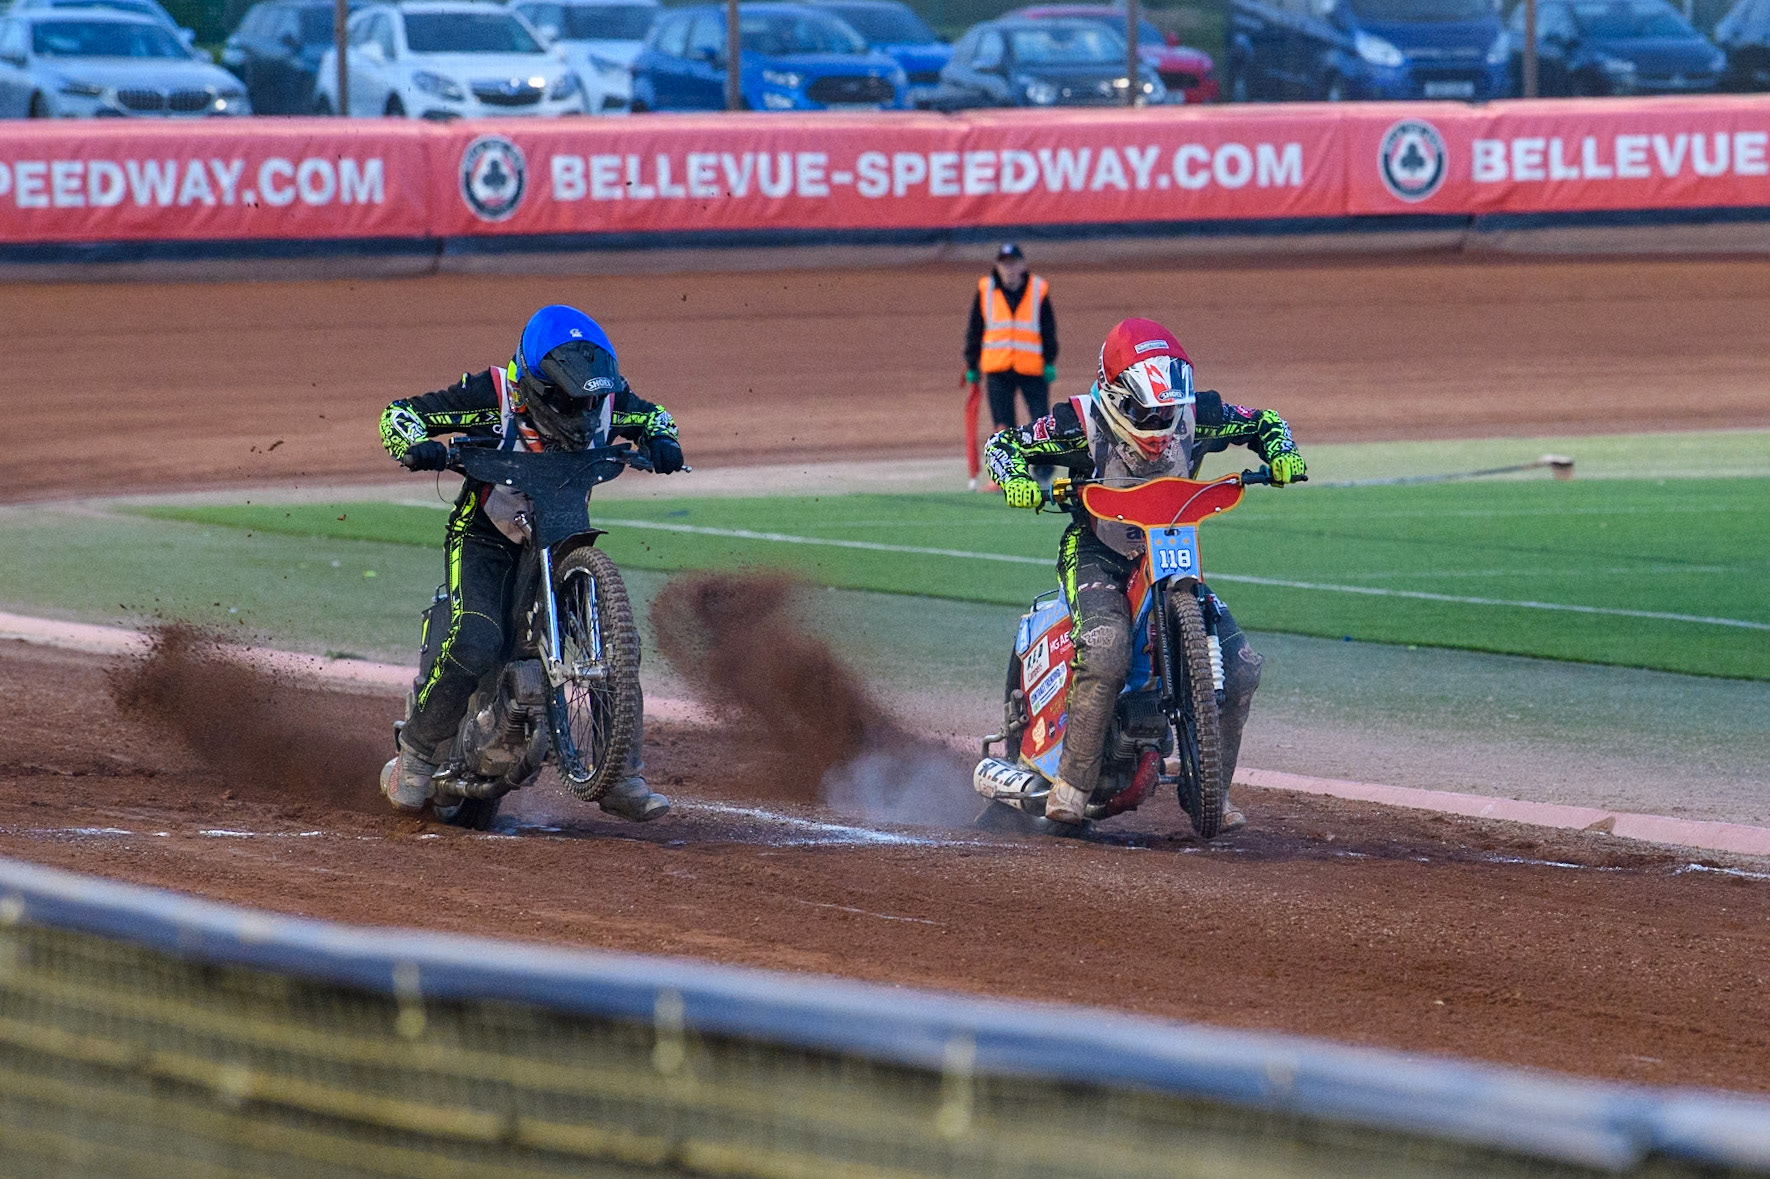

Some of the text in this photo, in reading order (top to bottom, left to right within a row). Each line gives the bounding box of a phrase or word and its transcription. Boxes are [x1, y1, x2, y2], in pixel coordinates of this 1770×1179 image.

[551, 143, 1304, 202] BELLEVUE-SPEEDWAY.COM
[1472, 131, 1770, 184] BELLEVUE
[587, 380, 611, 390] SHOEI
[1158, 548, 1192, 571] 118
